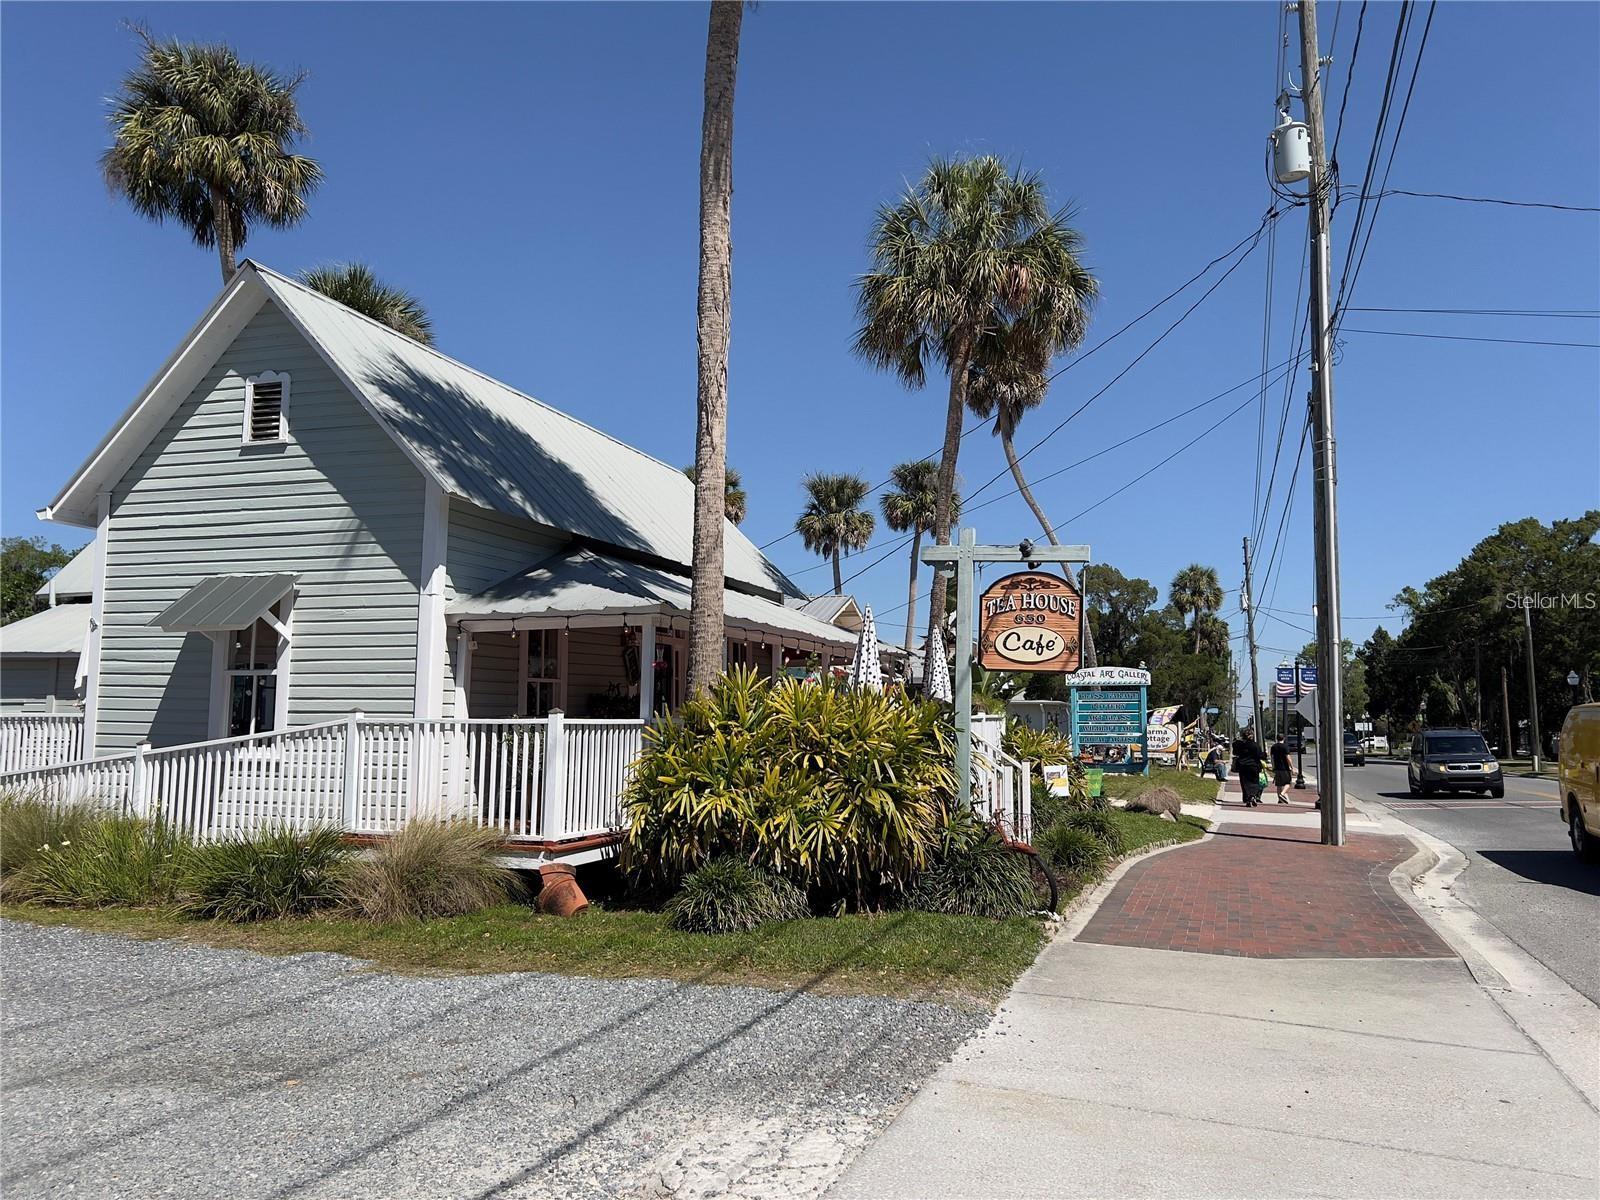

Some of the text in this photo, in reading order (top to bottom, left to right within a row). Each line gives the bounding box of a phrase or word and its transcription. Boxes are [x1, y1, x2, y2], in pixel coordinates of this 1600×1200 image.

[987, 592, 1076, 618] TEA HOUSE
[1014, 613, 1046, 625] 650
[1002, 631, 1058, 656] Café
[1067, 669, 1148, 681] COASTAL ART GALLERY
